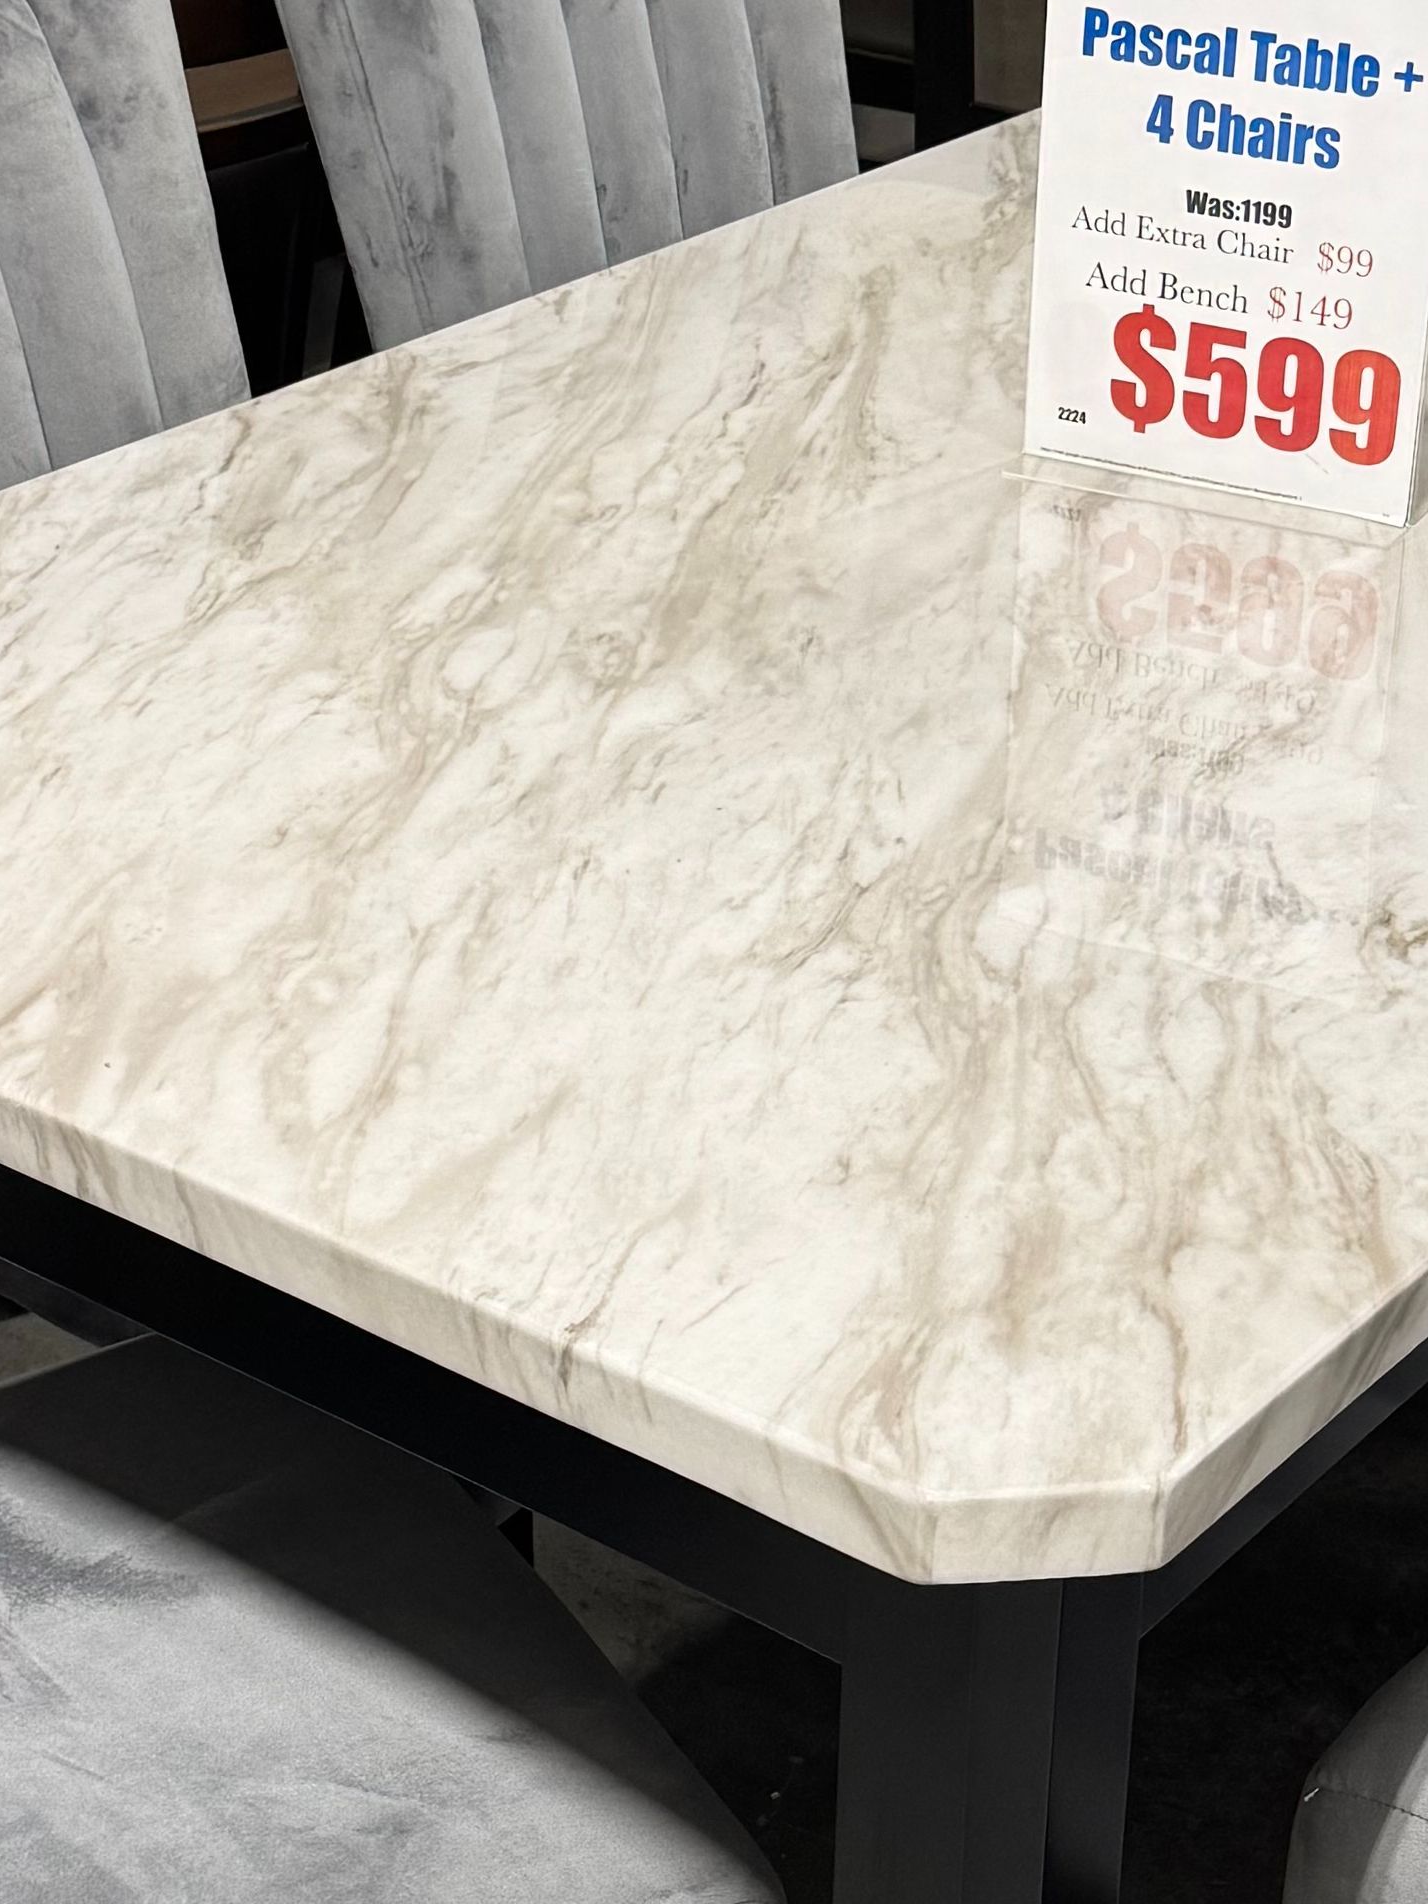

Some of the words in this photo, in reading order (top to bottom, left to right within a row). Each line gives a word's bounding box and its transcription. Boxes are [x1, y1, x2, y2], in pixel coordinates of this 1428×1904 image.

[1082, 6, 1238, 78] Pascal
[1250, 30, 1381, 97] Table
[1394, 62, 1424, 92] +
[1146, 94, 1174, 144] 4
[1186, 98, 1341, 169] Chairs
[1072, 205, 1126, 238] Add
[1136, 214, 1207, 251] Extra
[1217, 229, 1294, 265] Chair
[1316, 241, 1374, 278] $99
[1185, 189, 1293, 229] Was:1199
[1085, 261, 1147, 297] Add
[1157, 271, 1249, 314] Bench
[1267, 286, 1354, 331] $149
[1057, 406, 1087, 425] 2224
[1110, 303, 1402, 467] $599
